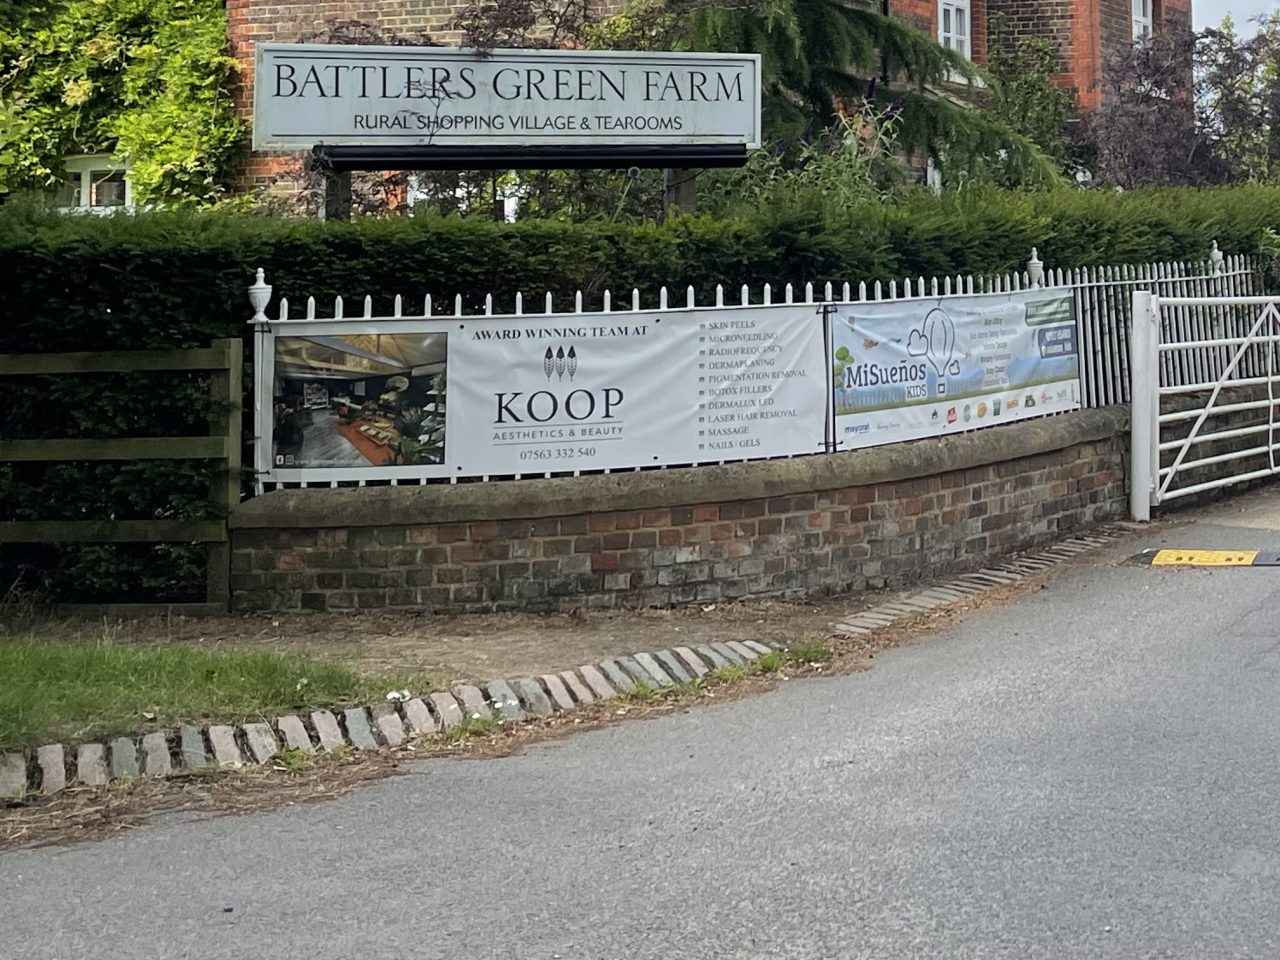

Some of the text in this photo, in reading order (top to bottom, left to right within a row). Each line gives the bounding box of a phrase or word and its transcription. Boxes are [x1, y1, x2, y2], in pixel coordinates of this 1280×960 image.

[272, 63, 745, 102] BATTLERS GREEN FARM
[354, 115, 682, 131] RURAL SHOPPING VILLAGE & TEAROOMS
[708, 320, 755, 330] SKIN PEELS
[472, 325, 649, 341] AWARD WINNING TEAM AT
[709, 332, 778, 343] MICRONEEDLING
[708, 345, 783, 356] RADIOFREQUENCY
[708, 359, 775, 370] DERMAPLANING
[708, 369, 807, 383] PIGMENTATION REMOVAL
[846, 360, 927, 388] MiSueños
[708, 385, 773, 396] BOTOX FILLERS
[906, 384, 927, 399] KIDS
[493, 388, 624, 424] KOOP
[708, 398, 774, 410] DERMALUX LED
[708, 409, 797, 423] LASER HAIR REMOVAL
[493, 426, 624, 441] AESTHETICS & BEAUTY
[708, 426, 749, 436] MASSAGE
[708, 440, 734, 449] NAILS
[739, 439, 761, 448] GELS
[520, 447, 596, 460] 07563 332 540
